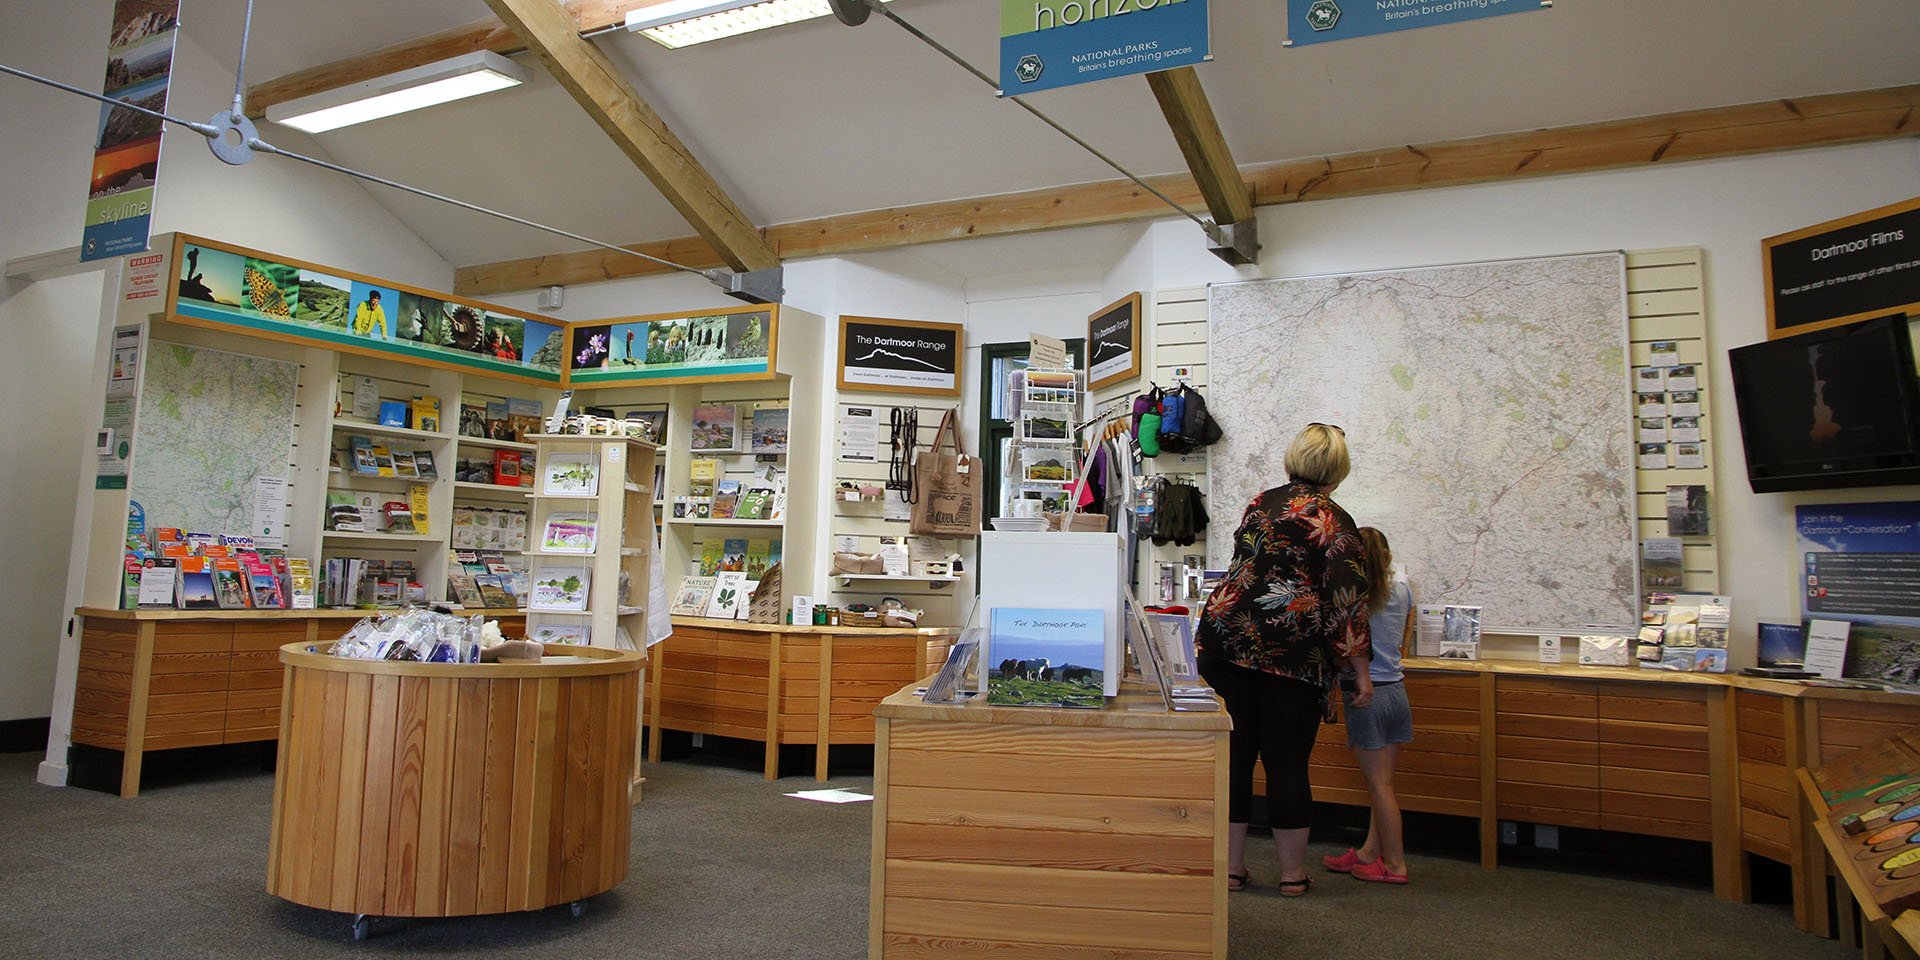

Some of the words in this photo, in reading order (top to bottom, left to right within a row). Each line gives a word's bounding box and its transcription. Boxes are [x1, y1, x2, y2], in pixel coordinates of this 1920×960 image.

[1385, 9, 1420, 20] Britain's
[1071, 47, 1124, 64] NATIONAL
[1125, 41, 1158, 55] PARKS
[1078, 61, 1107, 73] Britain's
[1108, 51, 1162, 68] breathing
[1163, 46, 1192, 59] spaces
[106, 185, 121, 197] the
[100, 200, 148, 225] skyline
[1811, 239, 1869, 261] Dartmoor
[1872, 229, 1904, 247] Films
[131, 255, 162, 267] WARNING
[1848, 272, 1867, 281] range
[1876, 265, 1894, 275] other
[1100, 325, 1117, 338] Dartmoor
[1117, 318, 1129, 330] Range
[856, 335, 872, 345] The
[874, 336, 916, 348] Dartmoor
[917, 339, 946, 351] Range
[1802, 515, 1819, 523] Join
[1820, 515, 1827, 523] in
[1829, 514, 1844, 523] the
[1803, 526, 1841, 535] Dartmoor
[227, 536, 254, 544] DEVON
